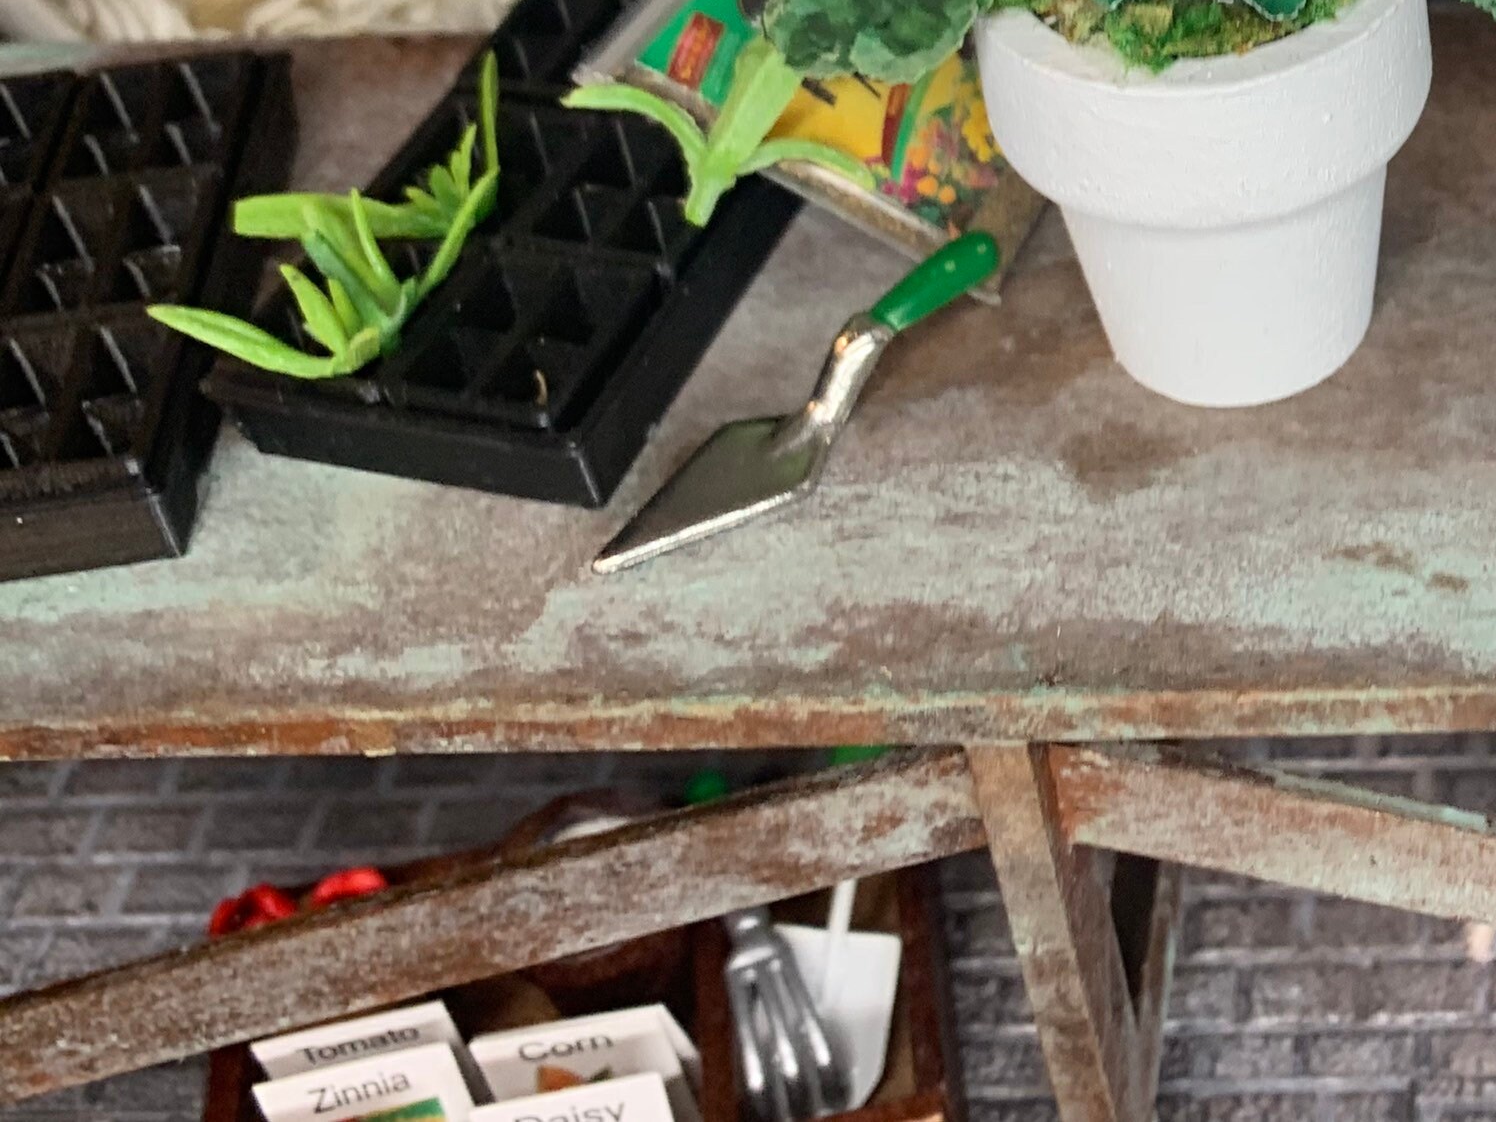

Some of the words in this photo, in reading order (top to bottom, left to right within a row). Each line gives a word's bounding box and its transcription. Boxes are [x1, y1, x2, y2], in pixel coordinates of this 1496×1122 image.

[296, 1027, 419, 1065] Tomato
[518, 1035, 613, 1062] Corn
[307, 1072, 411, 1114] Zinnia
[514, 1101, 625, 1122] isy
